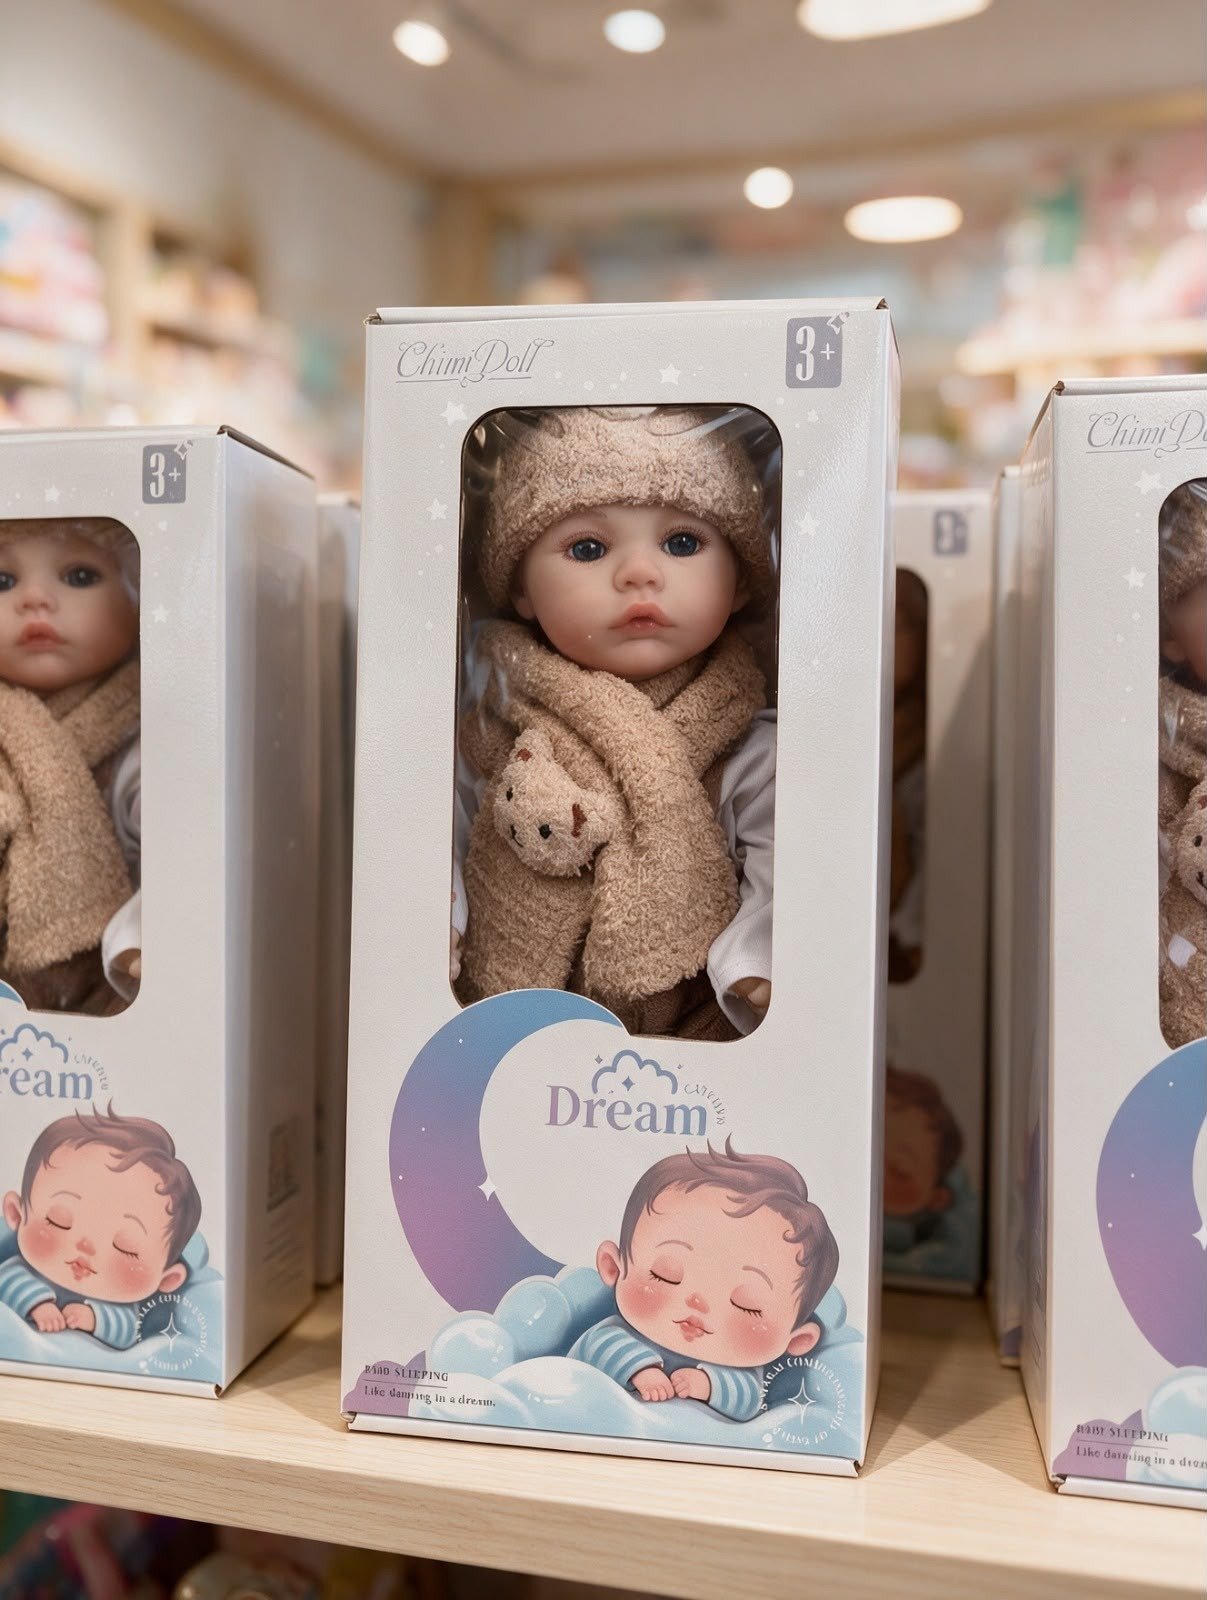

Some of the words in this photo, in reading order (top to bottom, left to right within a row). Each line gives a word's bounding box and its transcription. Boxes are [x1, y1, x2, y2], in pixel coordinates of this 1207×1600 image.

[794, 325, 836, 382] 3+
[149, 452, 182, 498] 3+
[545, 1084, 708, 1136] Dream
